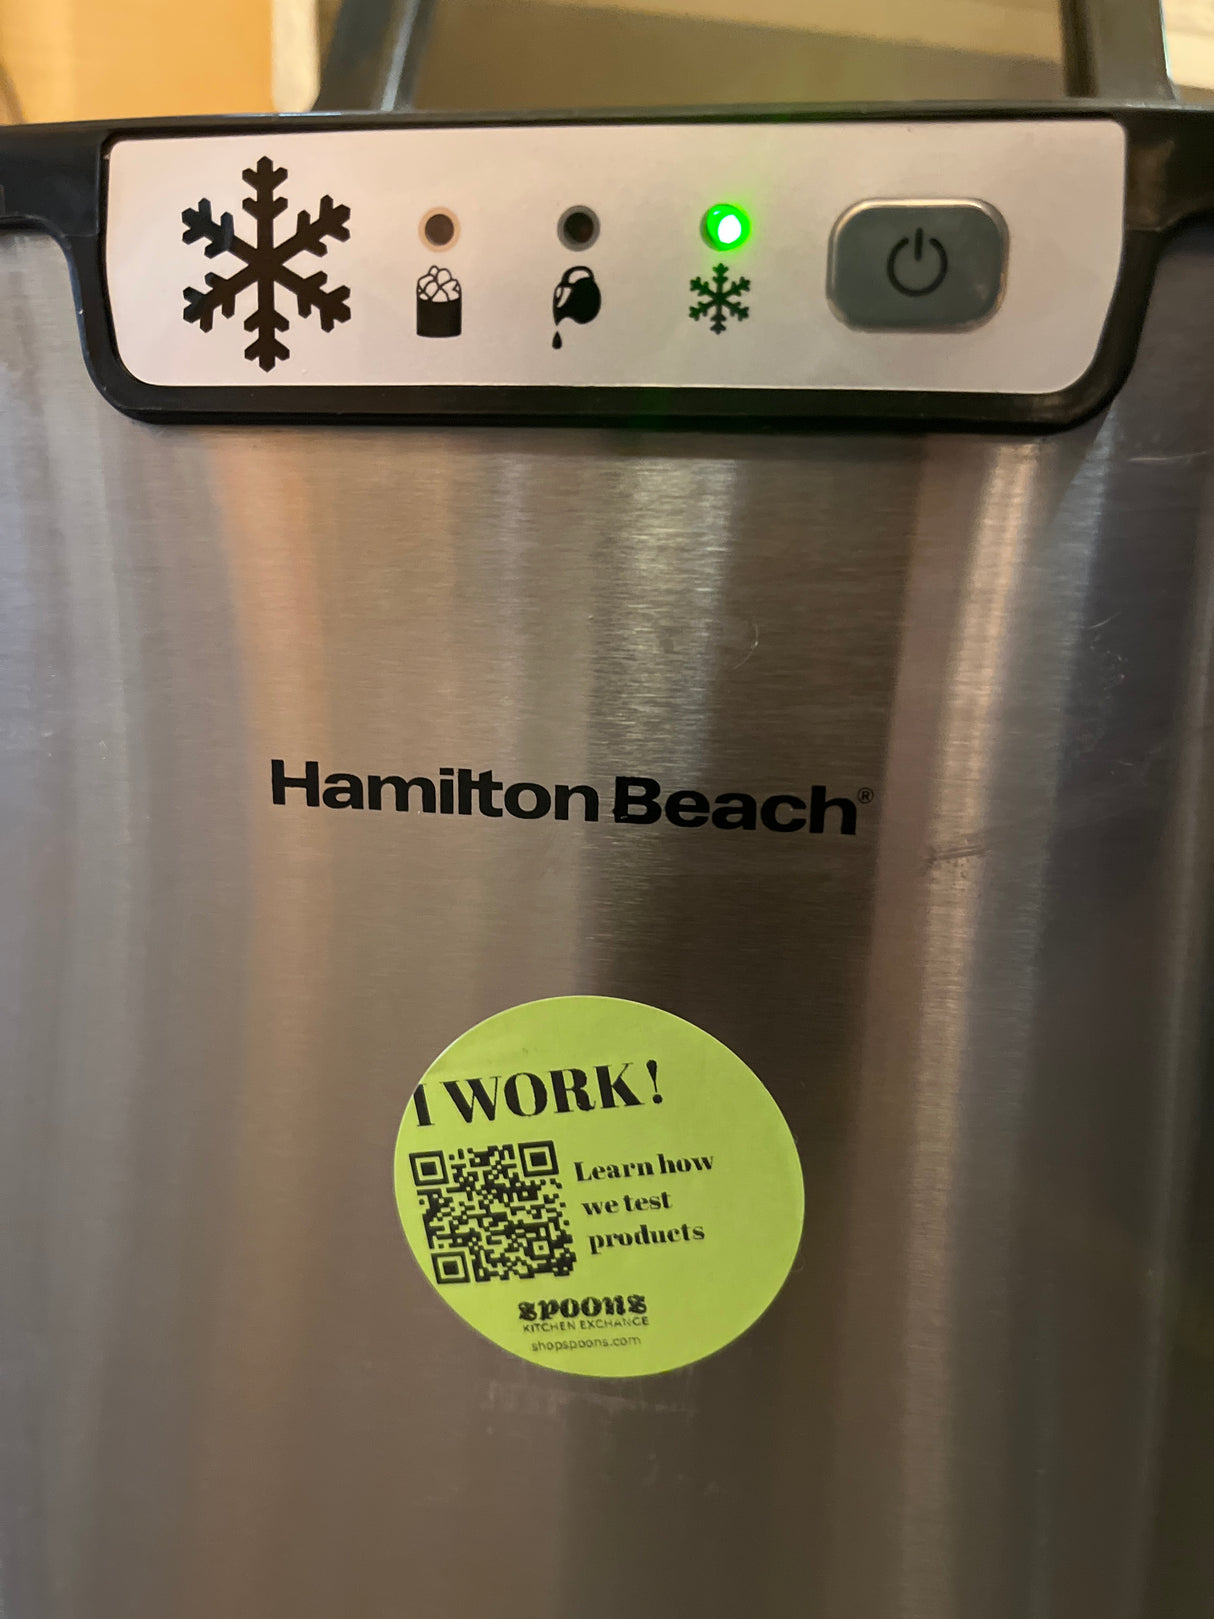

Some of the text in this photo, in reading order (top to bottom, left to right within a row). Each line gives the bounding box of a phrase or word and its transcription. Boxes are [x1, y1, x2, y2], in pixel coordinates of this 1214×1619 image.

[271, 759, 599, 822] Hamilton
[413, 1059, 663, 1127] I WORK!
[574, 1153, 714, 1182] Learn how
[582, 1192, 673, 1216] we test
[588, 1224, 706, 1255] products
[518, 1294, 647, 1321] spoons
[523, 1316, 650, 1333] KITCHEN EXCHANGE
[531, 1335, 642, 1352] shopspoons.com
